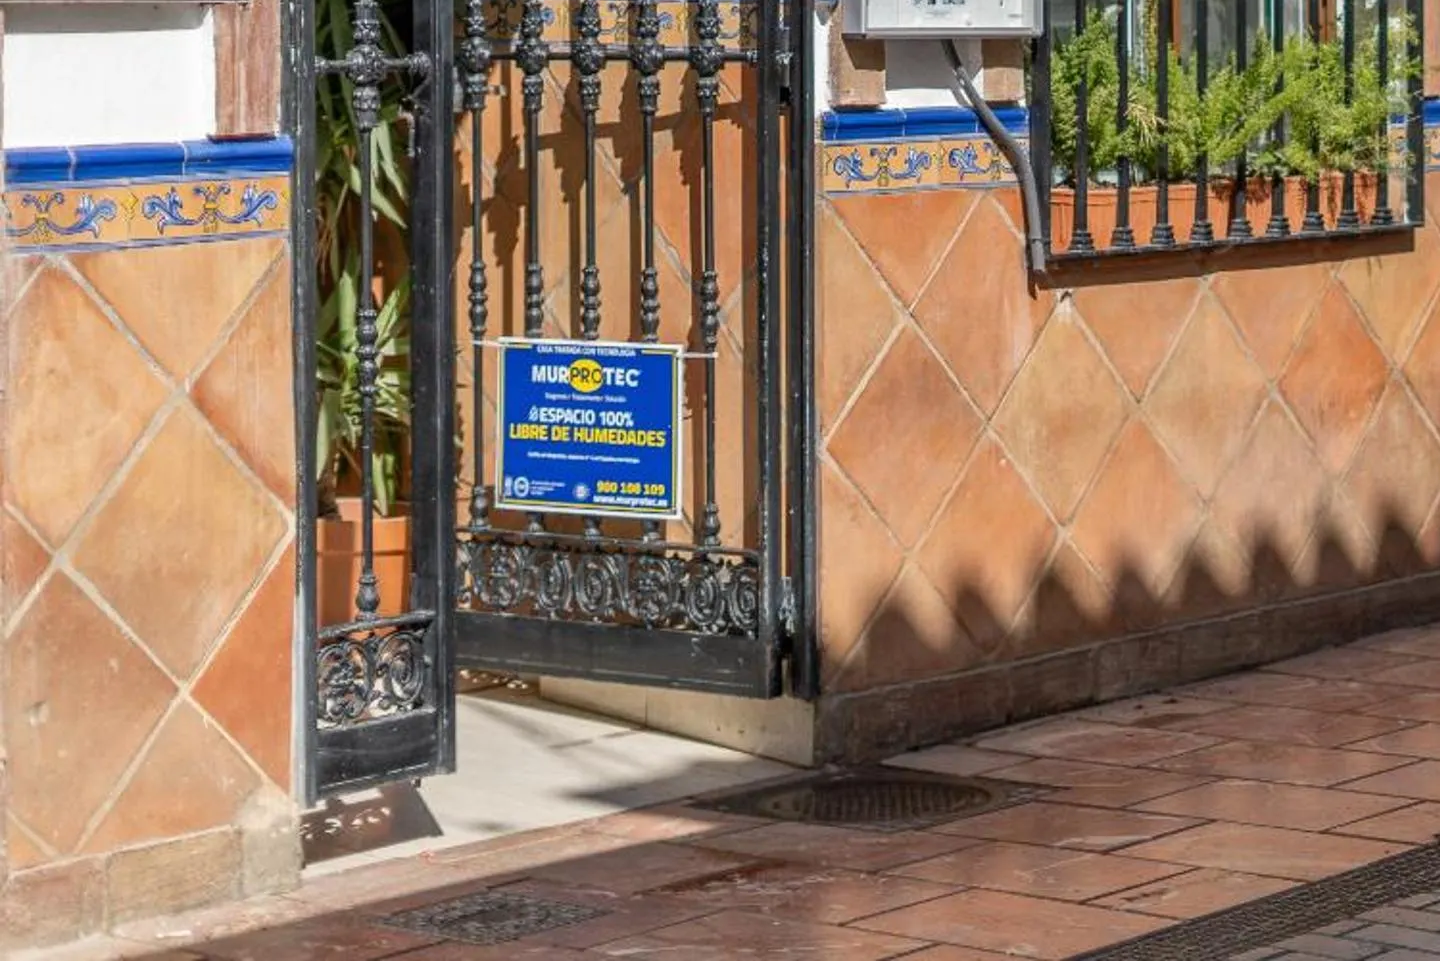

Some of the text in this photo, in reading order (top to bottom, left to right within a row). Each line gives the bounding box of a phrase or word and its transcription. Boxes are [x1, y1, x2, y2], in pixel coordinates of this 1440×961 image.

[531, 364, 641, 388] MURPROTEC
[539, 406, 634, 427] ESPACIO 100%
[509, 423, 667, 448] LIBRE DE HUMEDADES
